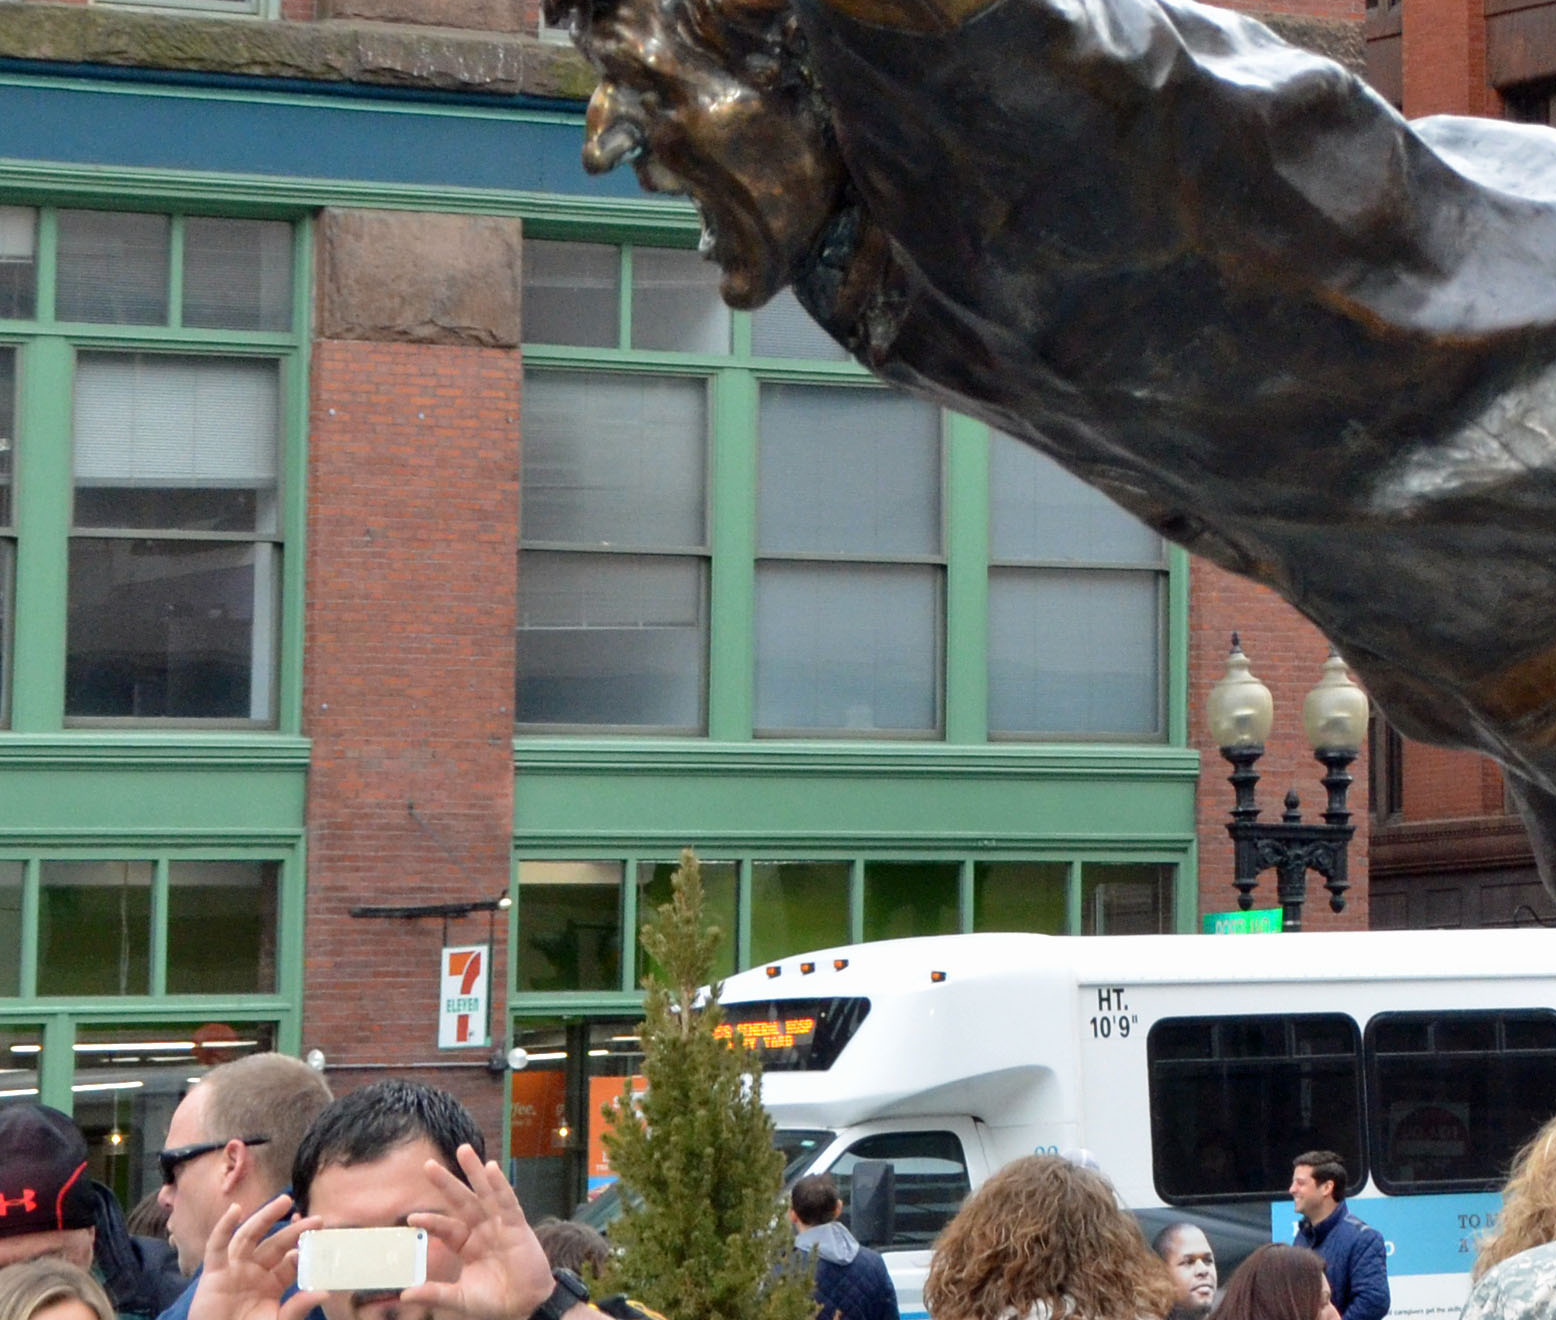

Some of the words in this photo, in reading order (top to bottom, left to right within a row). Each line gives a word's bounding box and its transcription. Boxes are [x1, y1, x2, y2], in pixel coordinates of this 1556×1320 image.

[448, 951, 481, 1042] 7
[1098, 988, 1128, 1011] HT.
[1090, 1014, 1138, 1038] 10'9"
[1457, 1213, 1481, 1229] TO
